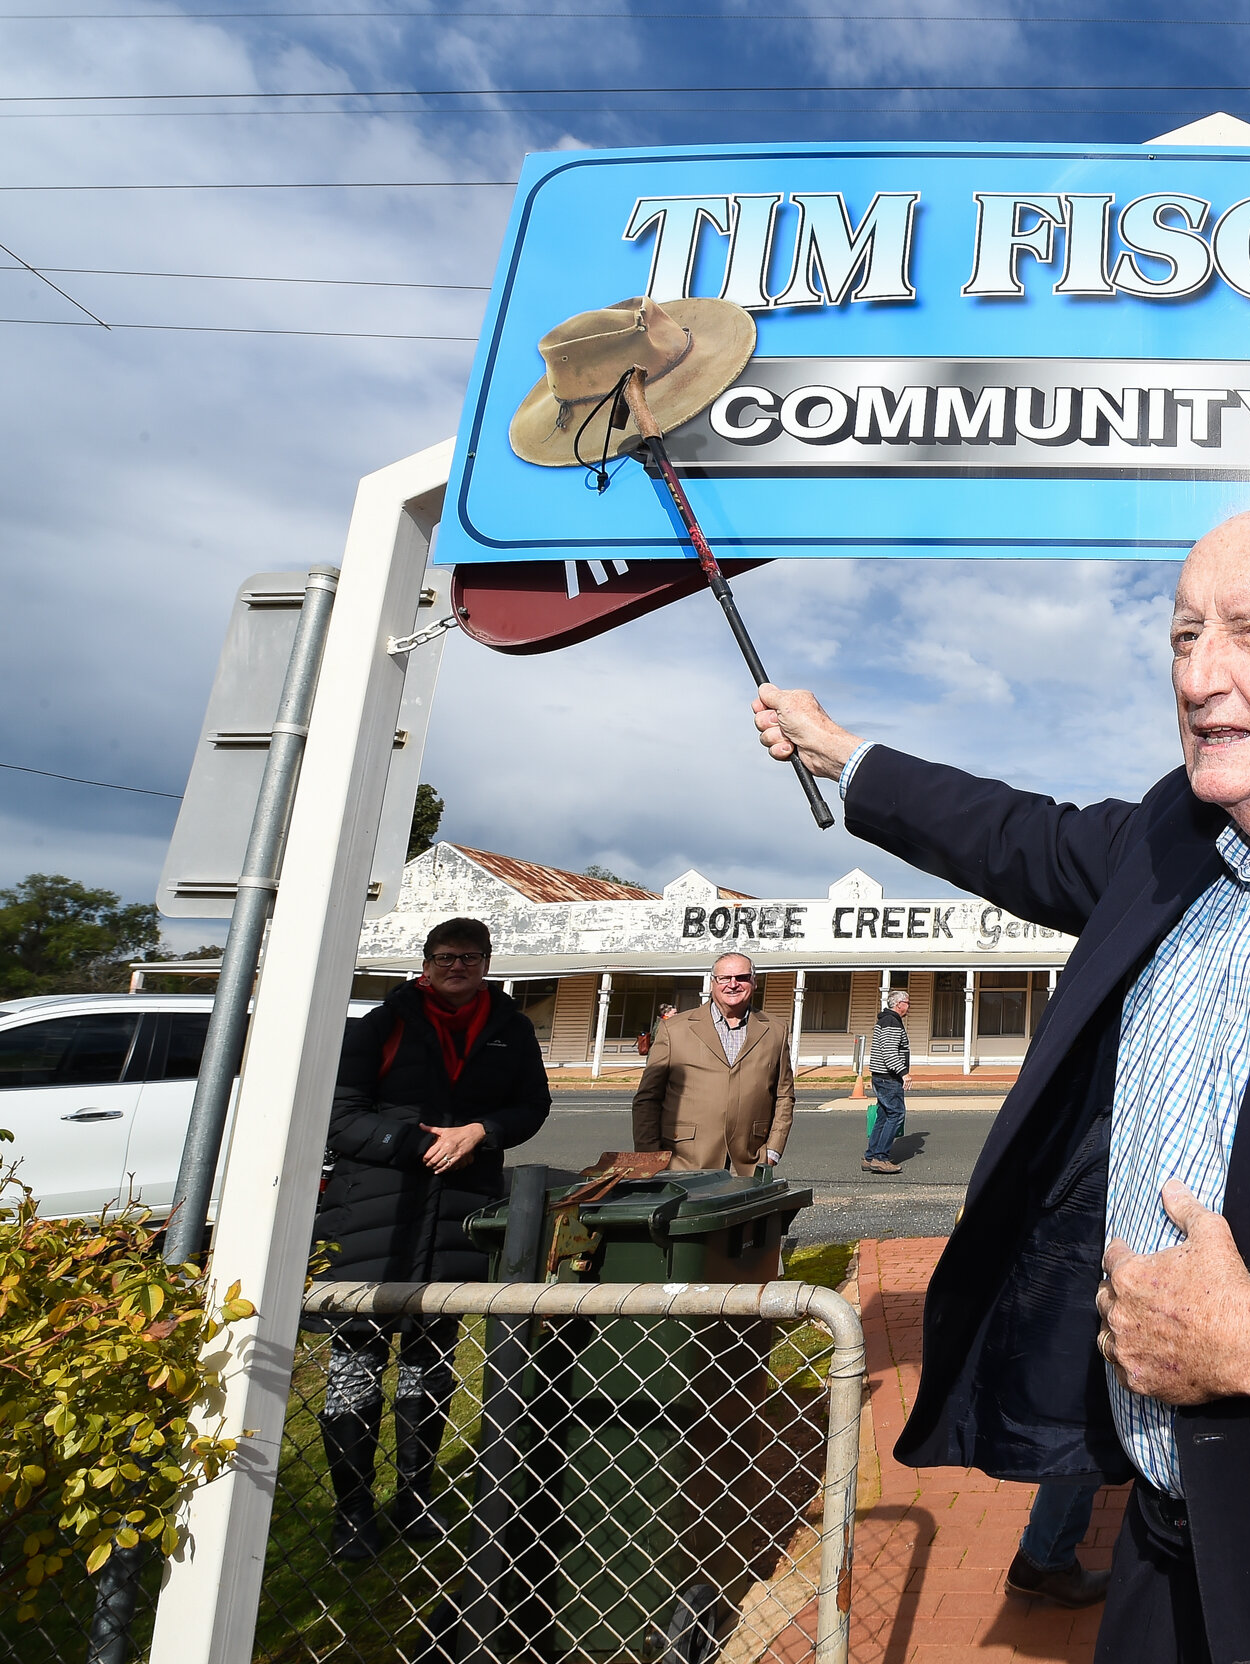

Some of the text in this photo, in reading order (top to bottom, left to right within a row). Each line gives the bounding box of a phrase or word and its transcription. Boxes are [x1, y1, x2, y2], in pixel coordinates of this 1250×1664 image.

[622, 191, 921, 311] TIM
[682, 905, 808, 939] BOREE
[831, 905, 956, 939] CREEK
